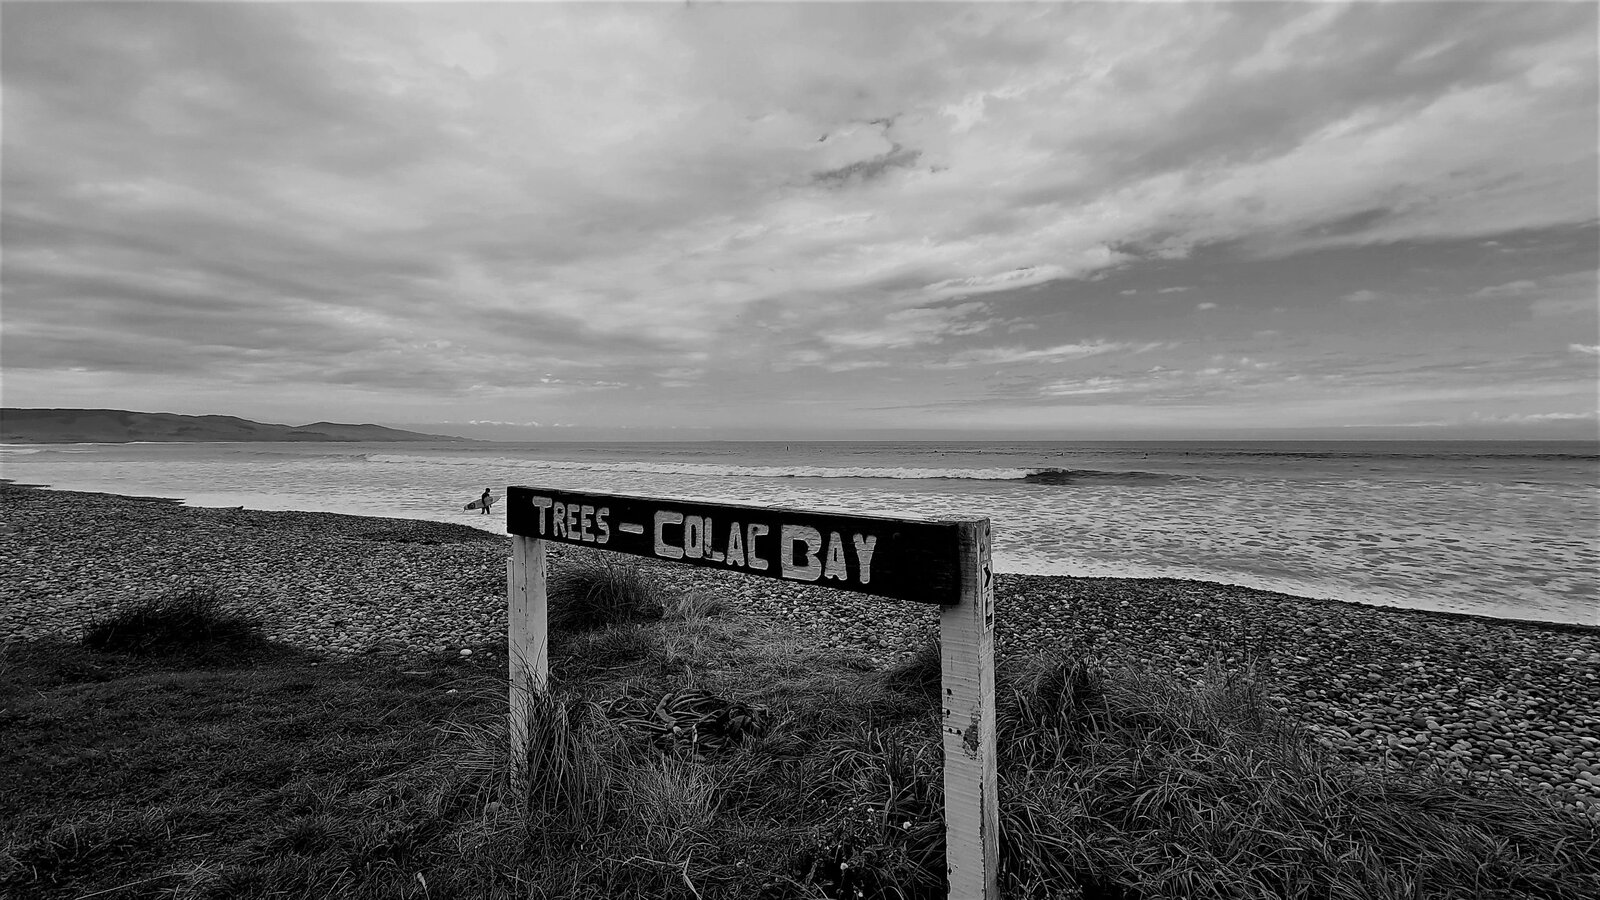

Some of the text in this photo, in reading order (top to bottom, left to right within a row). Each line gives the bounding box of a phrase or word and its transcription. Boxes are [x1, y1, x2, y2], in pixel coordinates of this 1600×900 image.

[532, 496, 610, 544] TREES
[653, 510, 770, 570] COLAC
[780, 524, 878, 584] BAY
